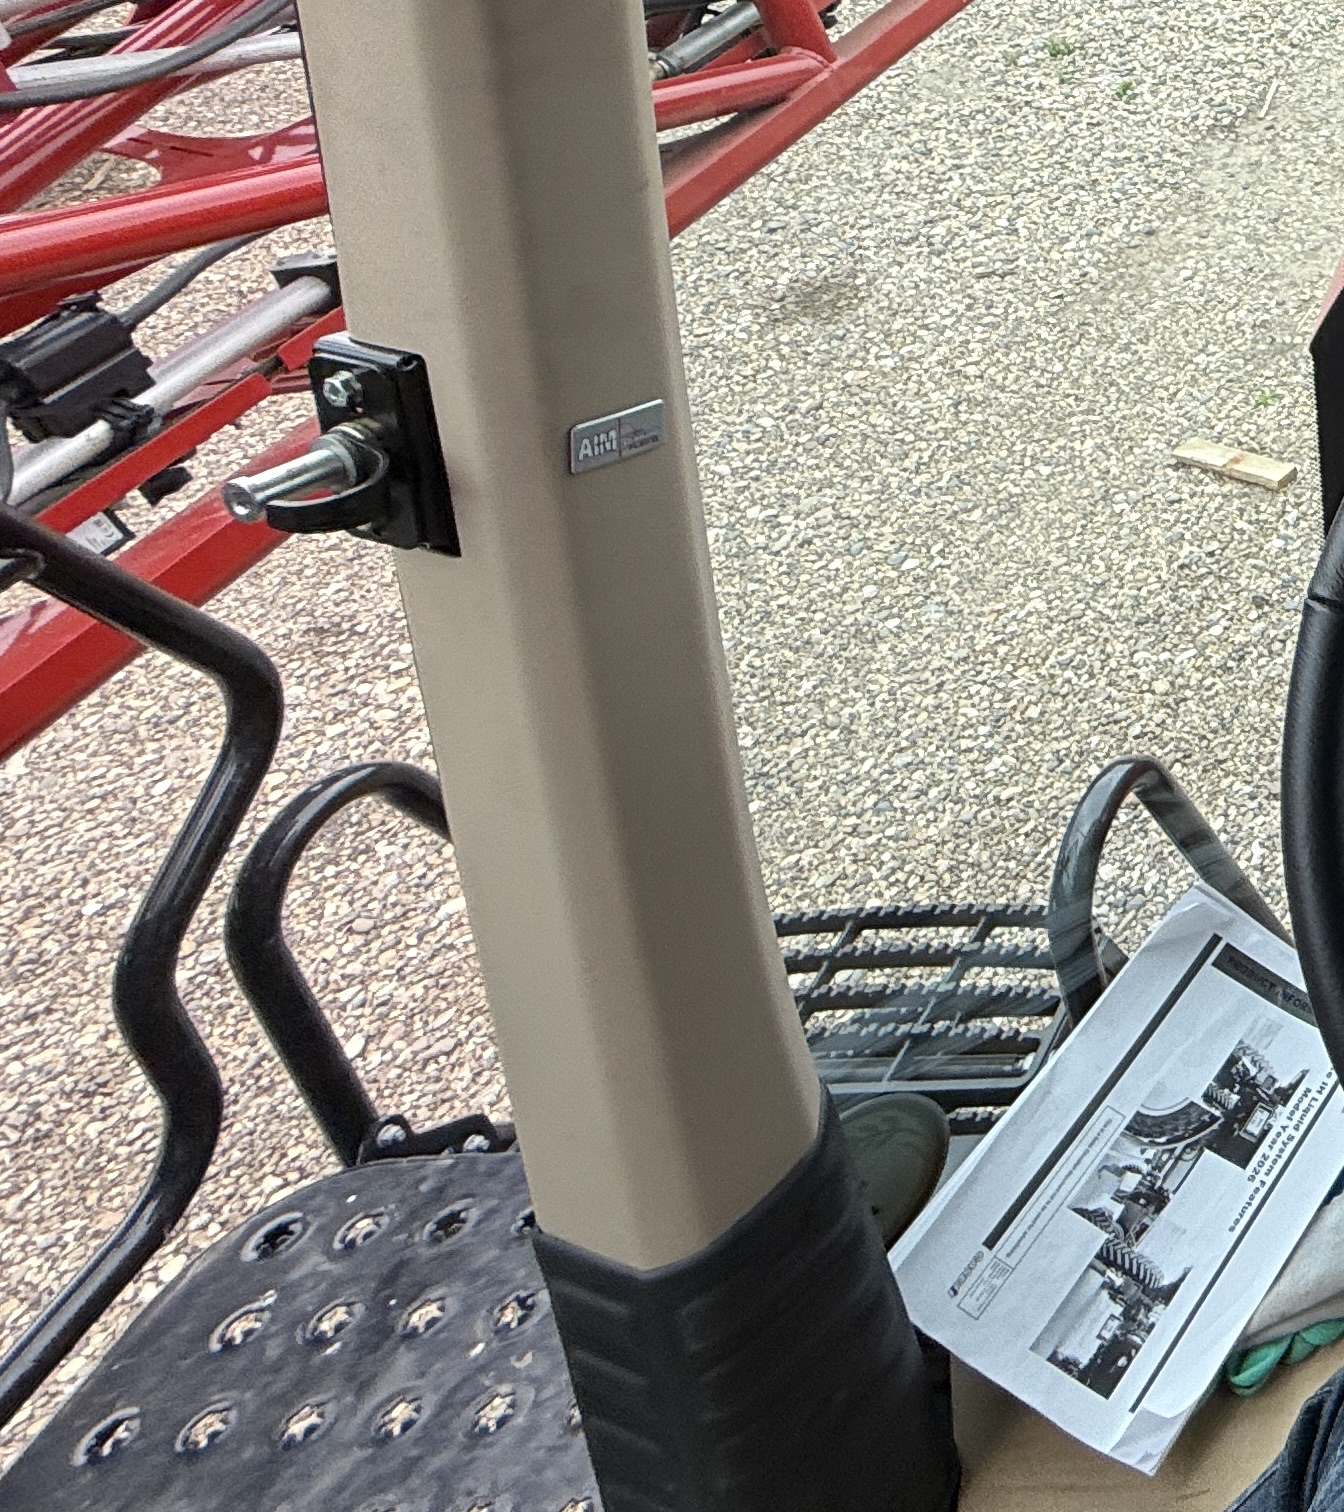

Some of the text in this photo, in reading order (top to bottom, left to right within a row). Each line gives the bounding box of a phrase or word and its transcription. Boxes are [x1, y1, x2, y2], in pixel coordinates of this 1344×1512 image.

[1246, 1086, 1312, 1183] Model Year 2026
[1291, 1095, 1319, 1132] Liquid
[1263, 1132, 1295, 1177] System
[1227, 1179, 1266, 1233] Features
